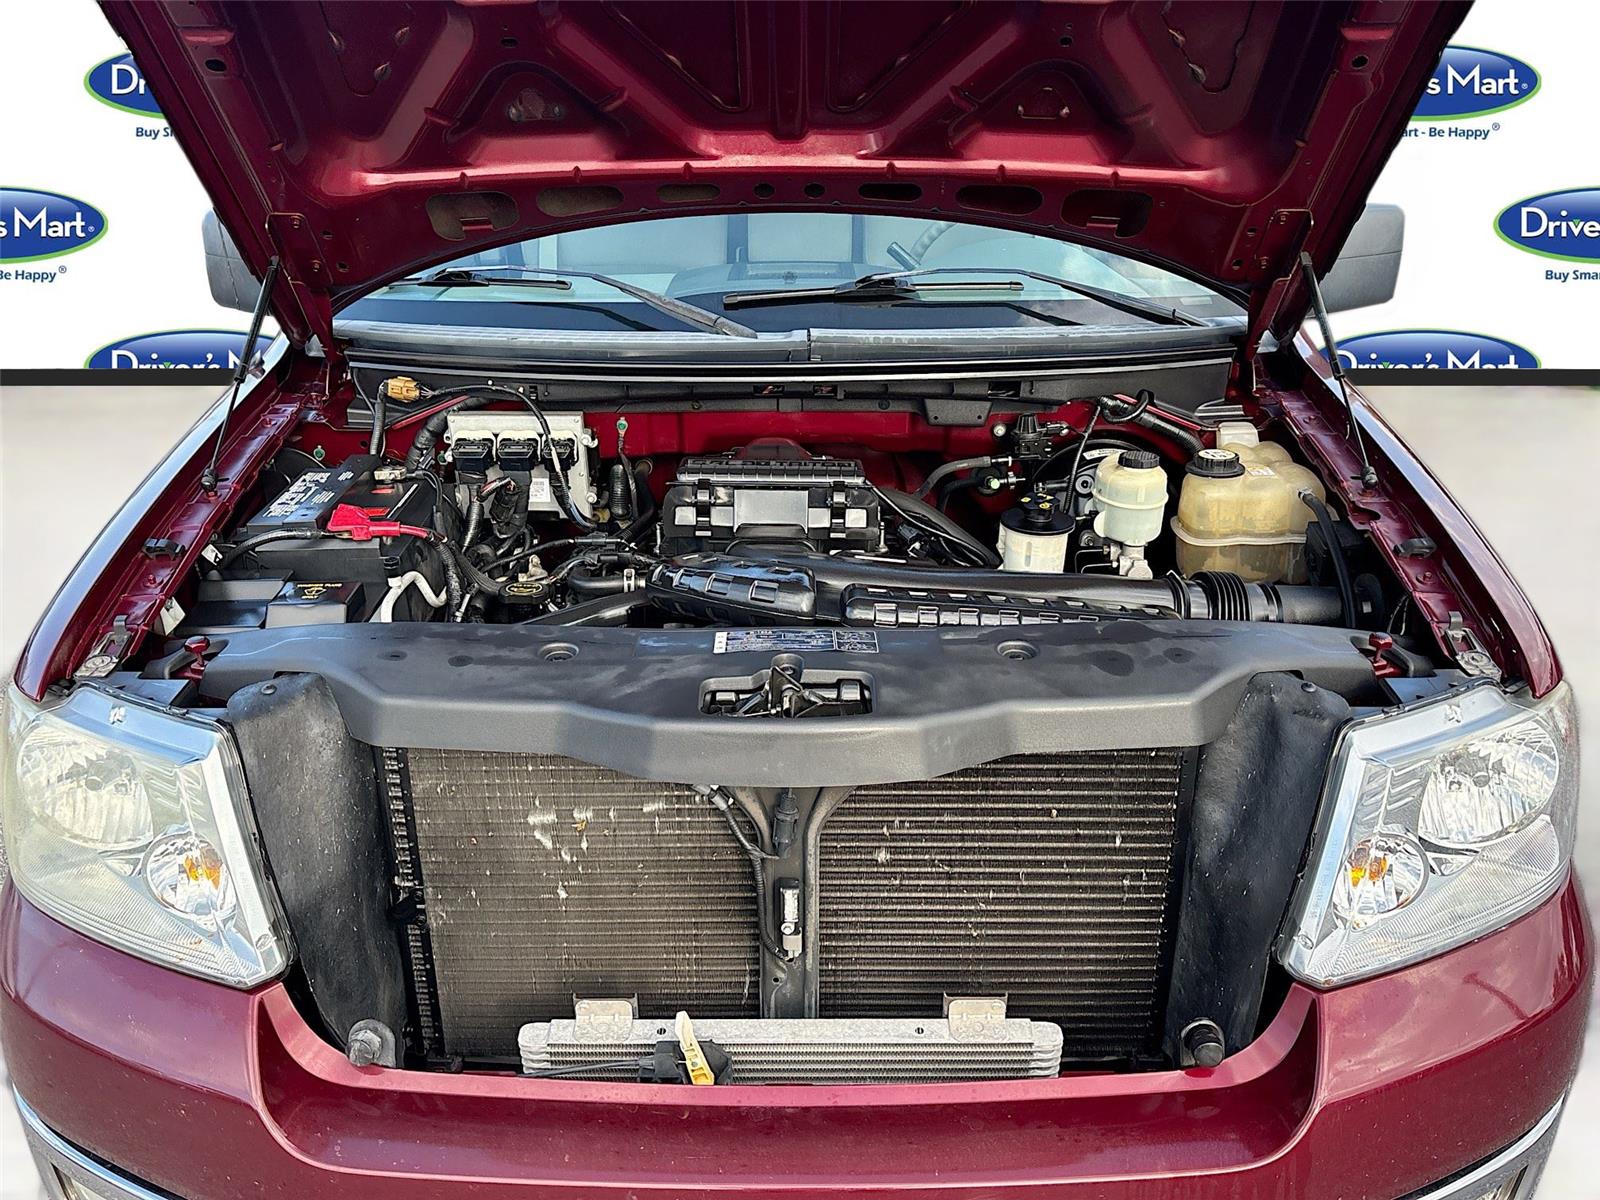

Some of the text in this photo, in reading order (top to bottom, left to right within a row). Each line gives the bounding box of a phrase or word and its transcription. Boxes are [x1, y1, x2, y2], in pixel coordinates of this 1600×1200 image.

[1447, 63, 1519, 94] Mart
[135, 127, 160, 140] Buy
[1429, 127, 1445, 137] Be
[1448, 127, 1490, 140] Happy
[14, 206, 86, 237] Mart
[15, 270, 57, 283] Happy
[1545, 270, 1600, 283] Buy Sma
